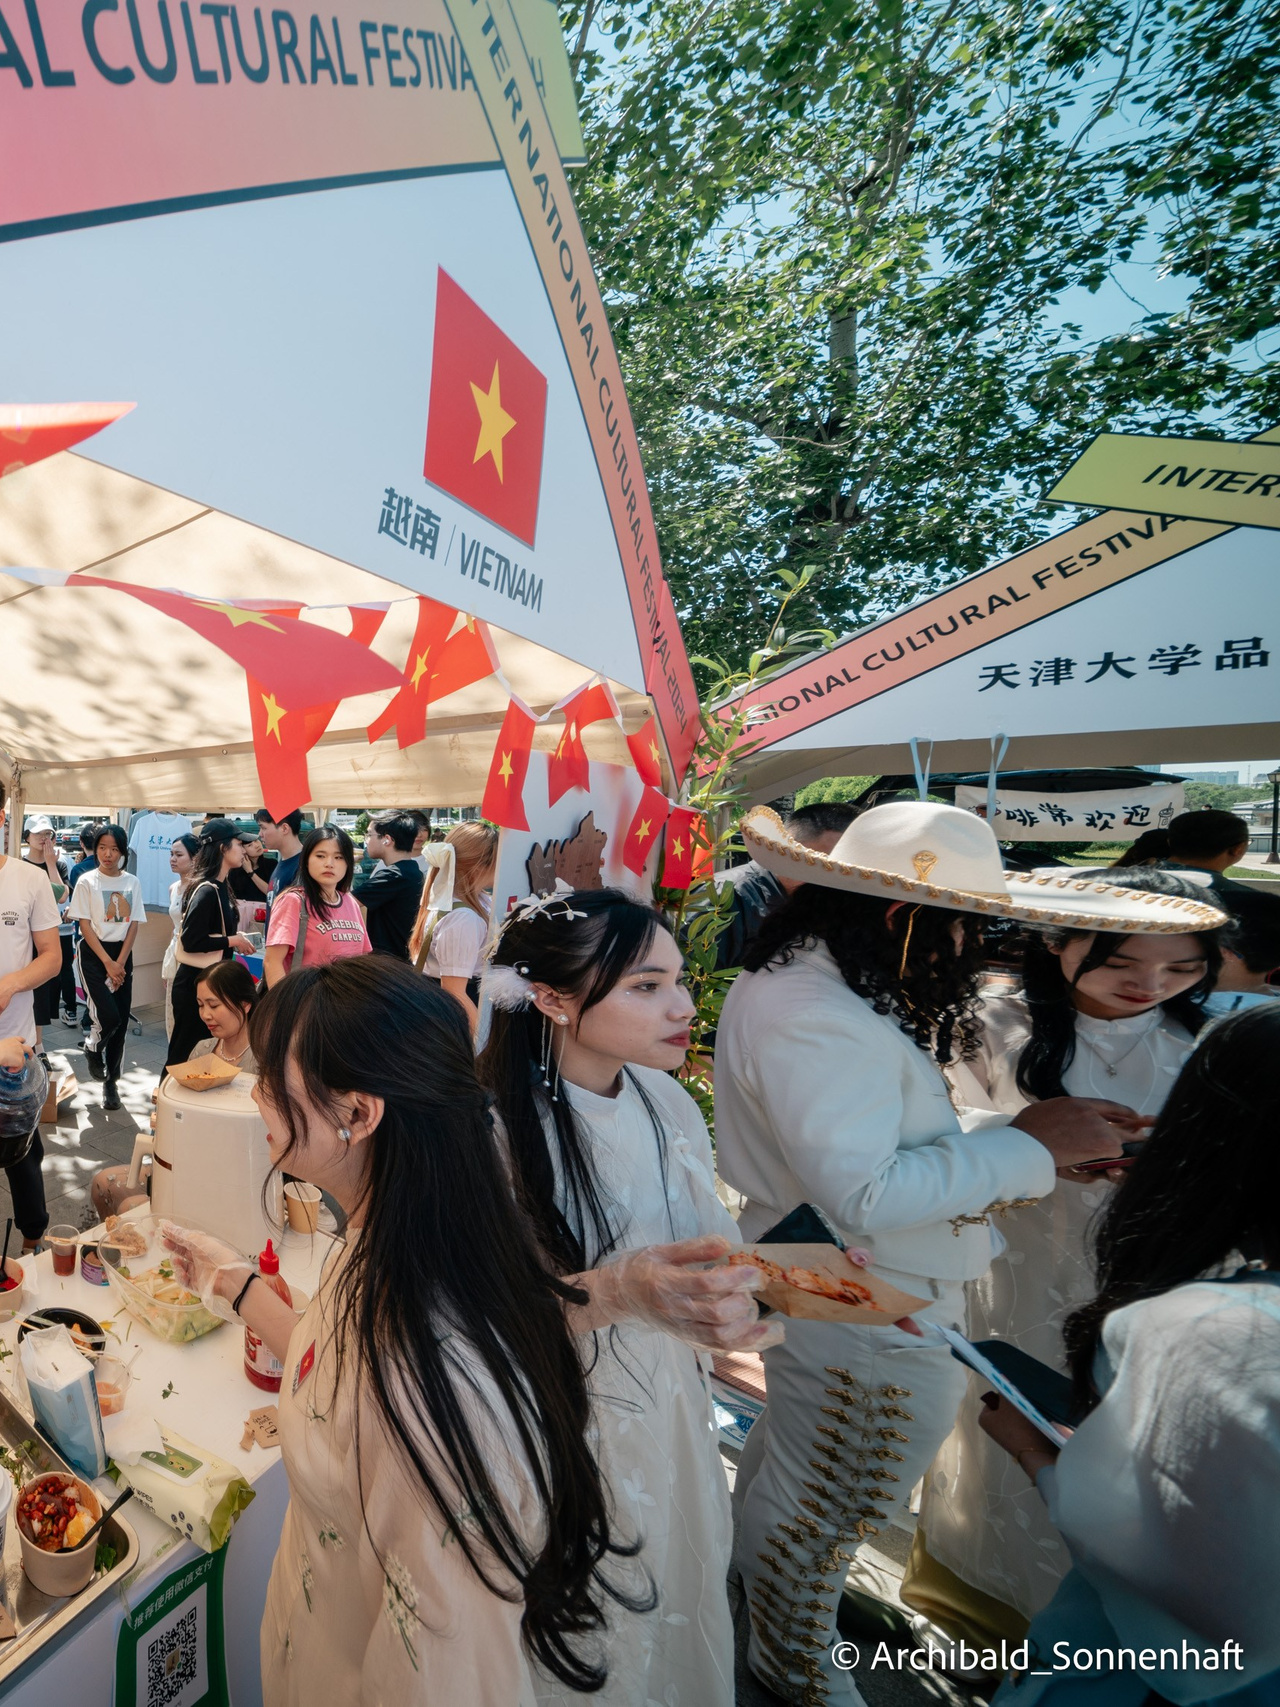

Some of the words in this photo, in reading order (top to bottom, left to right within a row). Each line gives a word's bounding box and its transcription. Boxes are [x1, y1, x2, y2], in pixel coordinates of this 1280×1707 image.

[81, 0, 359, 86] CULTURAL
[359, 20, 478, 92] FESTIVA
[471, 0, 600, 381] TERNATIONAL
[598, 376, 645, 562] CULTURAL
[666, 668, 688, 736] 2024
[1141, 463, 1280, 498] INTER
[377, 486, 442, 561] 越南
[460, 530, 544, 614] VIETNAM
[861, 585, 1031, 672] CULTURAL
[1030, 514, 1189, 591] FESTIVA
[977, 636, 1271, 693] 天津大学品
[148, 834, 173, 845] 天津大
[1005, 802, 1151, 831] 啡常欢迎
[331, 932, 362, 941] CAMPUS
[133, 1557, 214, 1631] 推荐使用微信支付
